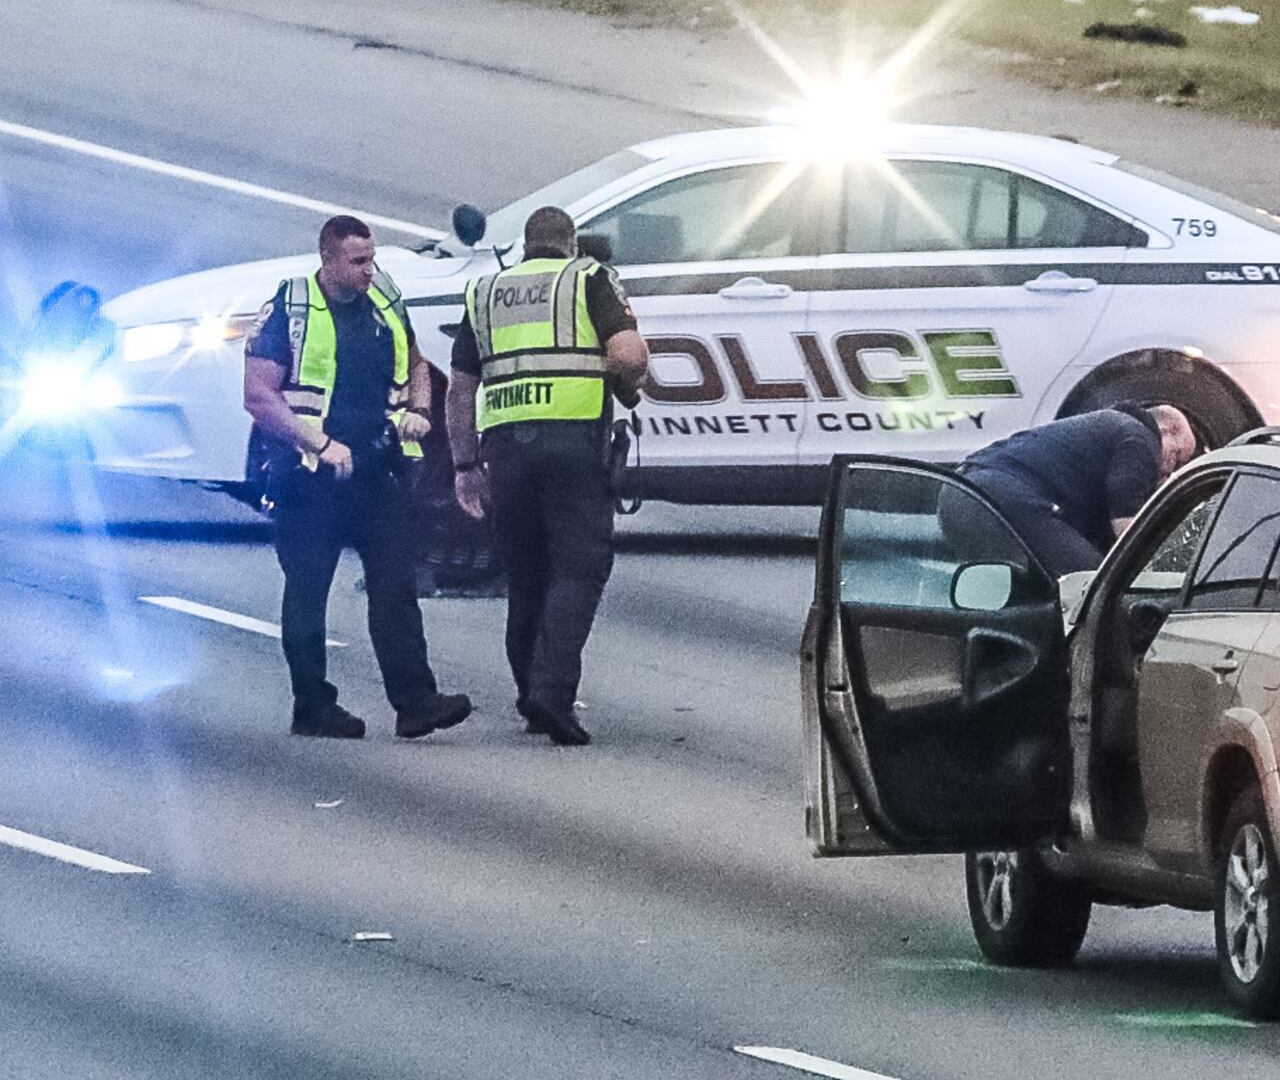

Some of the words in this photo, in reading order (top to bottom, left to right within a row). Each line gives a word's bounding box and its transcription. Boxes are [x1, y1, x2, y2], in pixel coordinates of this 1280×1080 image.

[1172, 218, 1217, 237] 759
[494, 284, 550, 308] POLICE
[640, 328, 1022, 405] OLICE
[625, 414, 798, 435] WINNETT
[817, 412, 985, 432] COUNTY
